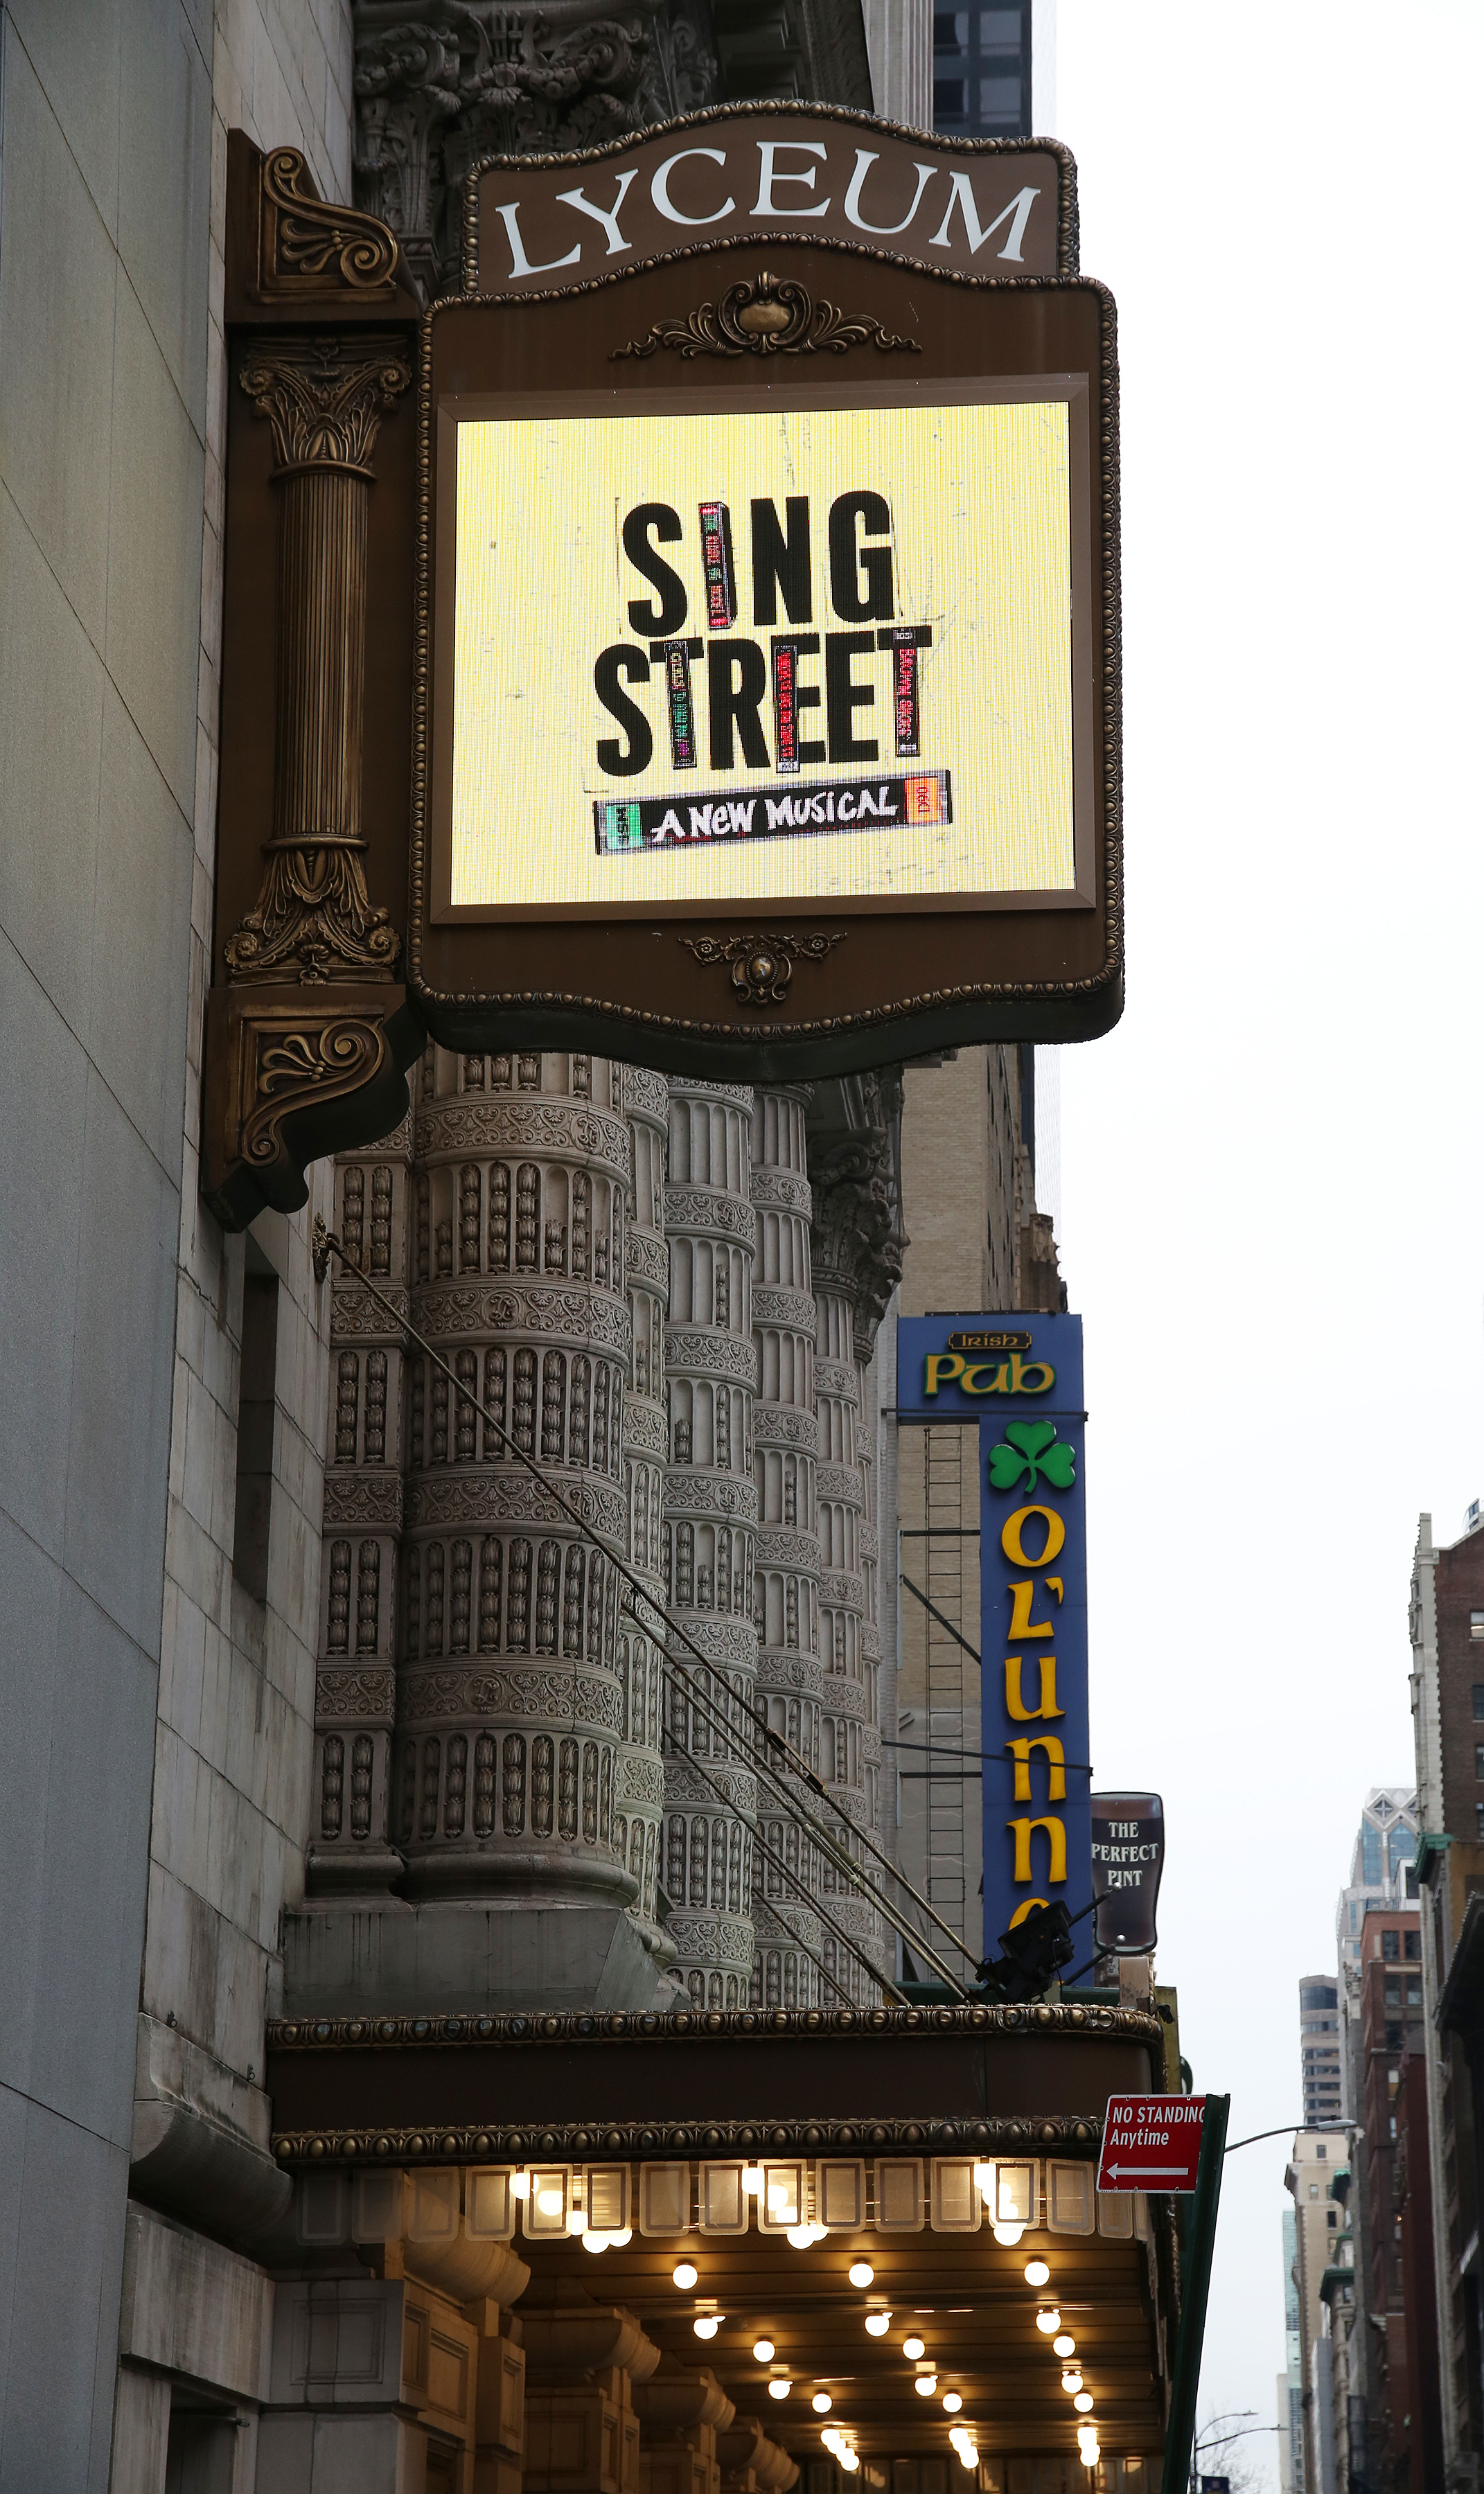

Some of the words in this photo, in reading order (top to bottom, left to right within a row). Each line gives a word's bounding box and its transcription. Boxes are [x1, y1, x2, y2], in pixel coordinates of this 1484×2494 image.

[495, 141, 1041, 279] LYCEUM
[622, 490, 895, 637] SING
[594, 624, 933, 777] STREET
[650, 808, 686, 844] A
[924, 1352, 1057, 1395] Pub
[1108, 1821, 1139, 1838] THE
[1091, 1843, 1159, 1862] PERFECT
[1108, 1869, 1143, 1887] PINT
[1113, 2107, 1133, 2123] NO
[1110, 2128, 1169, 2149] Anytime
